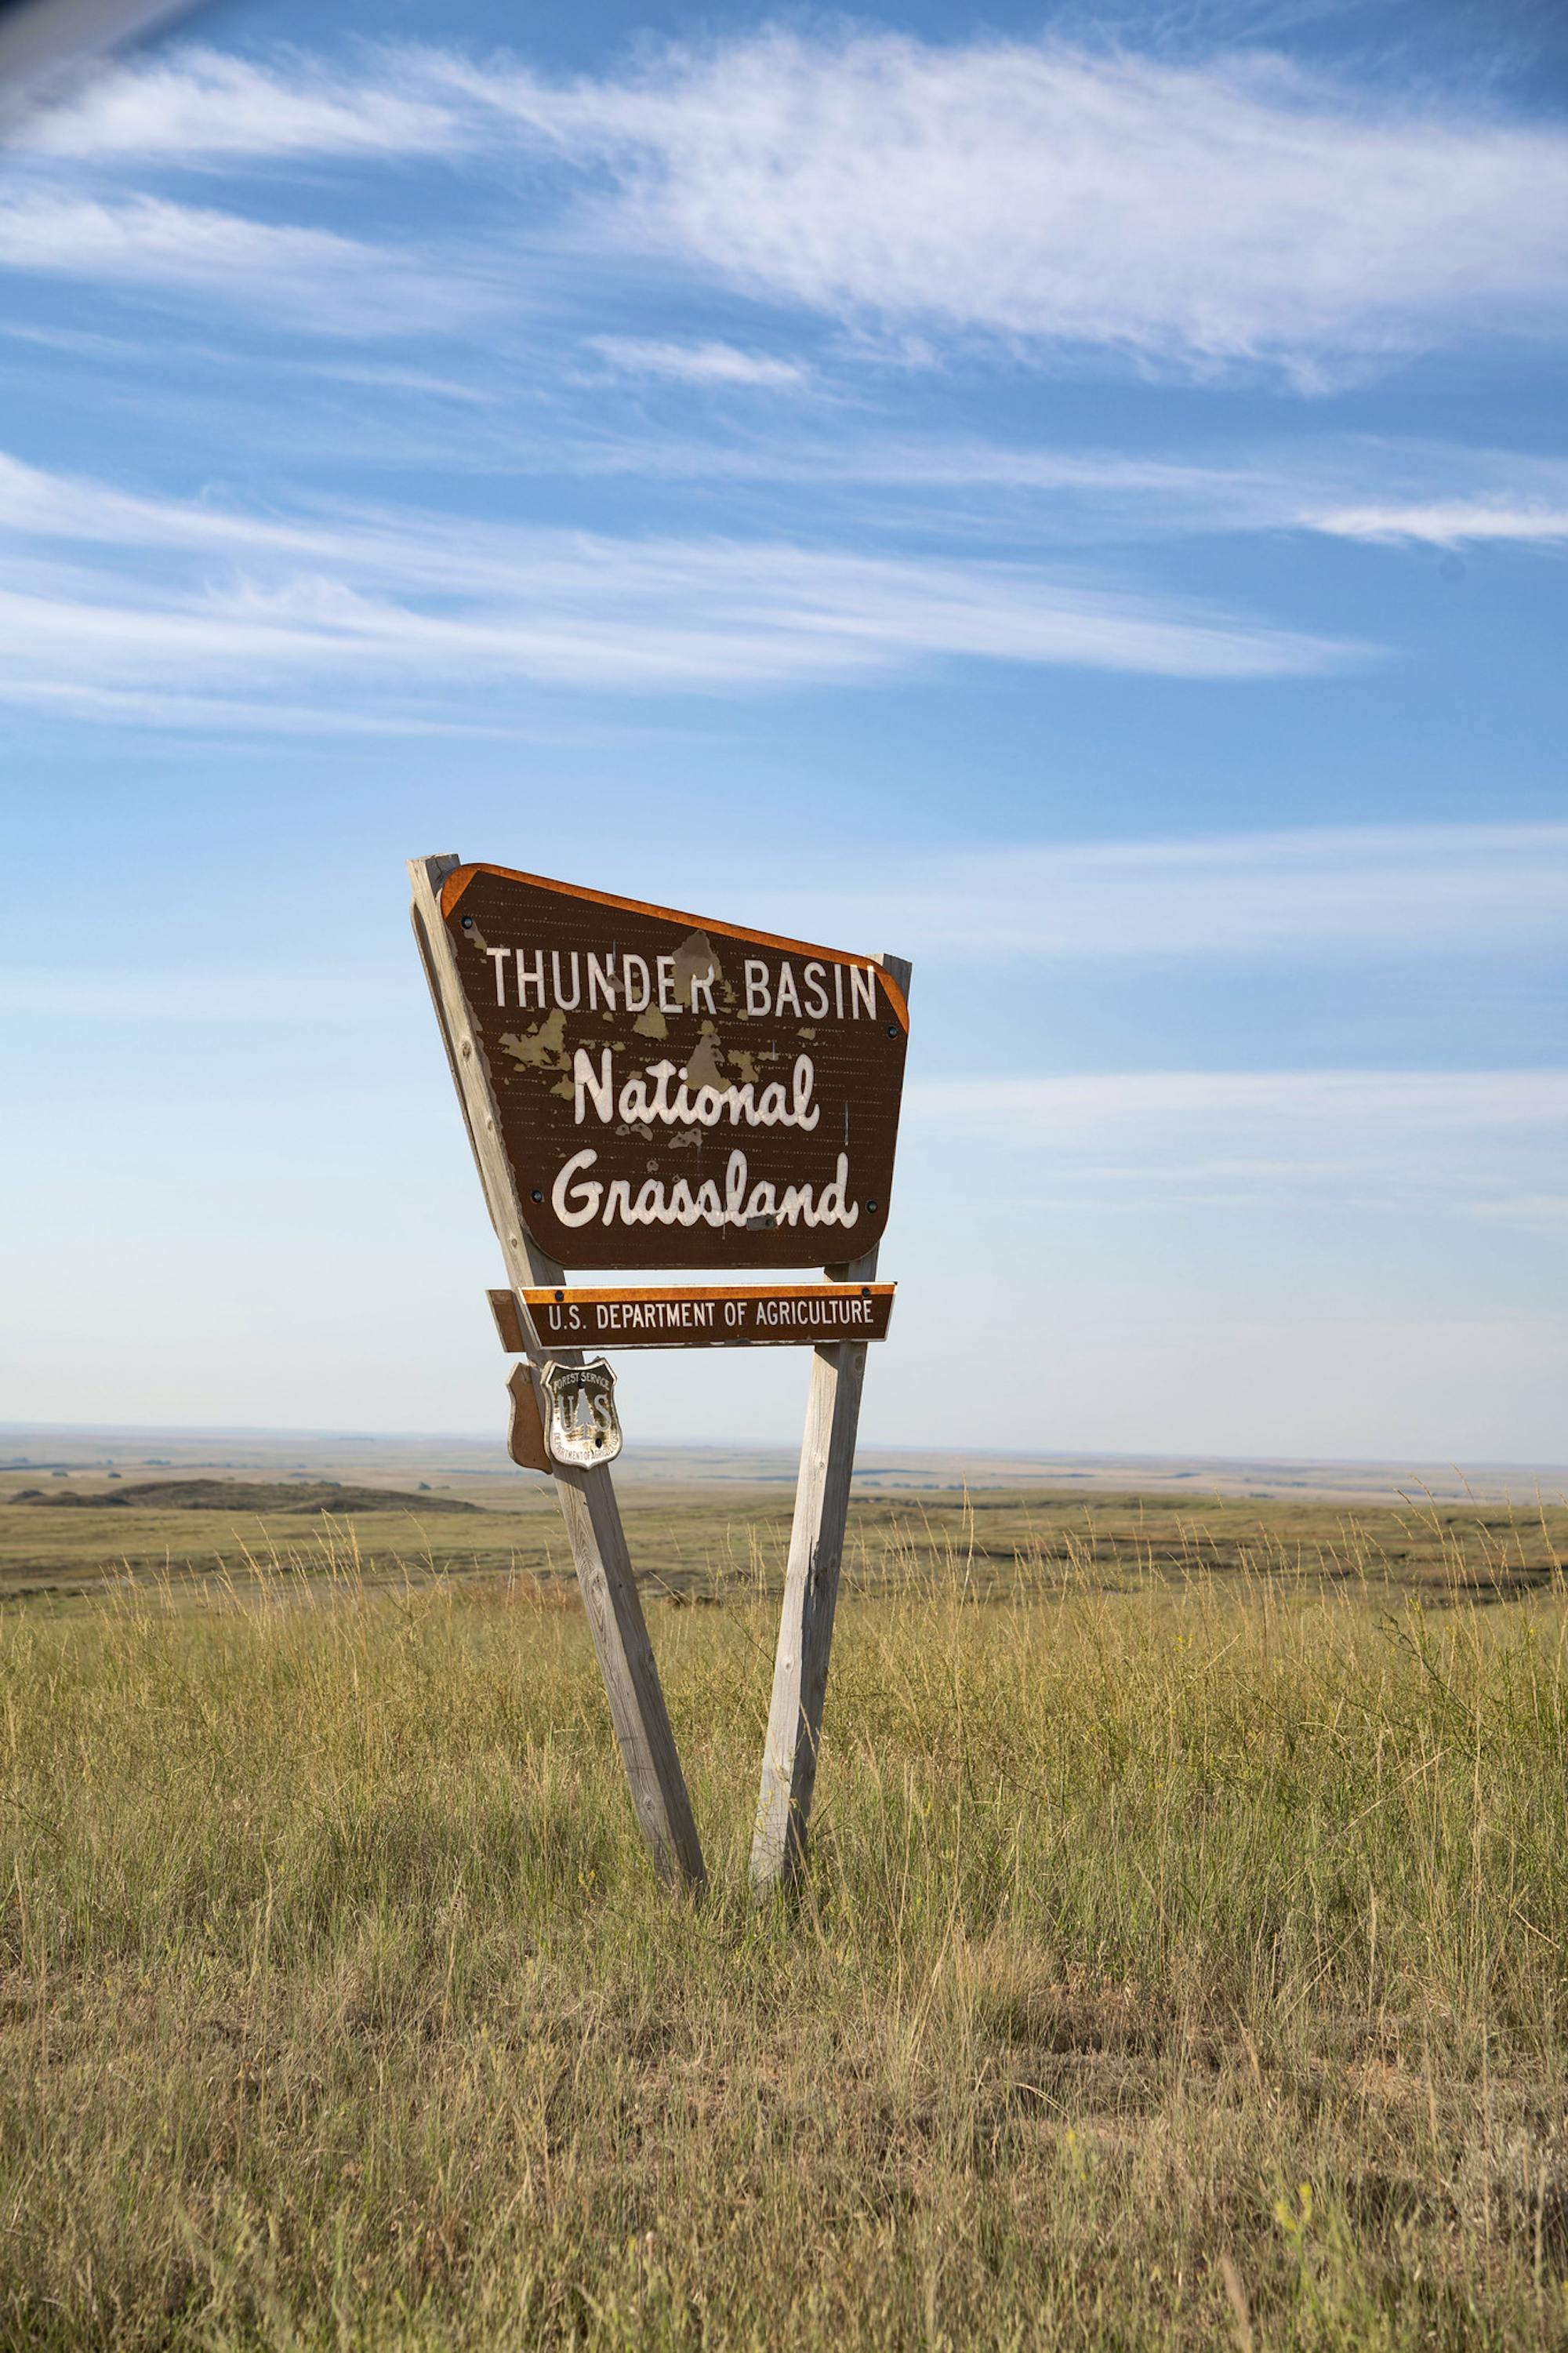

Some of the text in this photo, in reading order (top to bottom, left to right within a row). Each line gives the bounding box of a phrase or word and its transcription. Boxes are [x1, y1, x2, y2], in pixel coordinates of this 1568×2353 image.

[487, 947, 877, 1020] THUNDER BASIN
[574, 1048, 820, 1131] National
[551, 1148, 859, 1229] Grassland
[549, 1299, 874, 1331] U.S. DEPARTMENT OF AGRICULTURE
[554, 1371, 610, 1390] FOREST SERVICE
